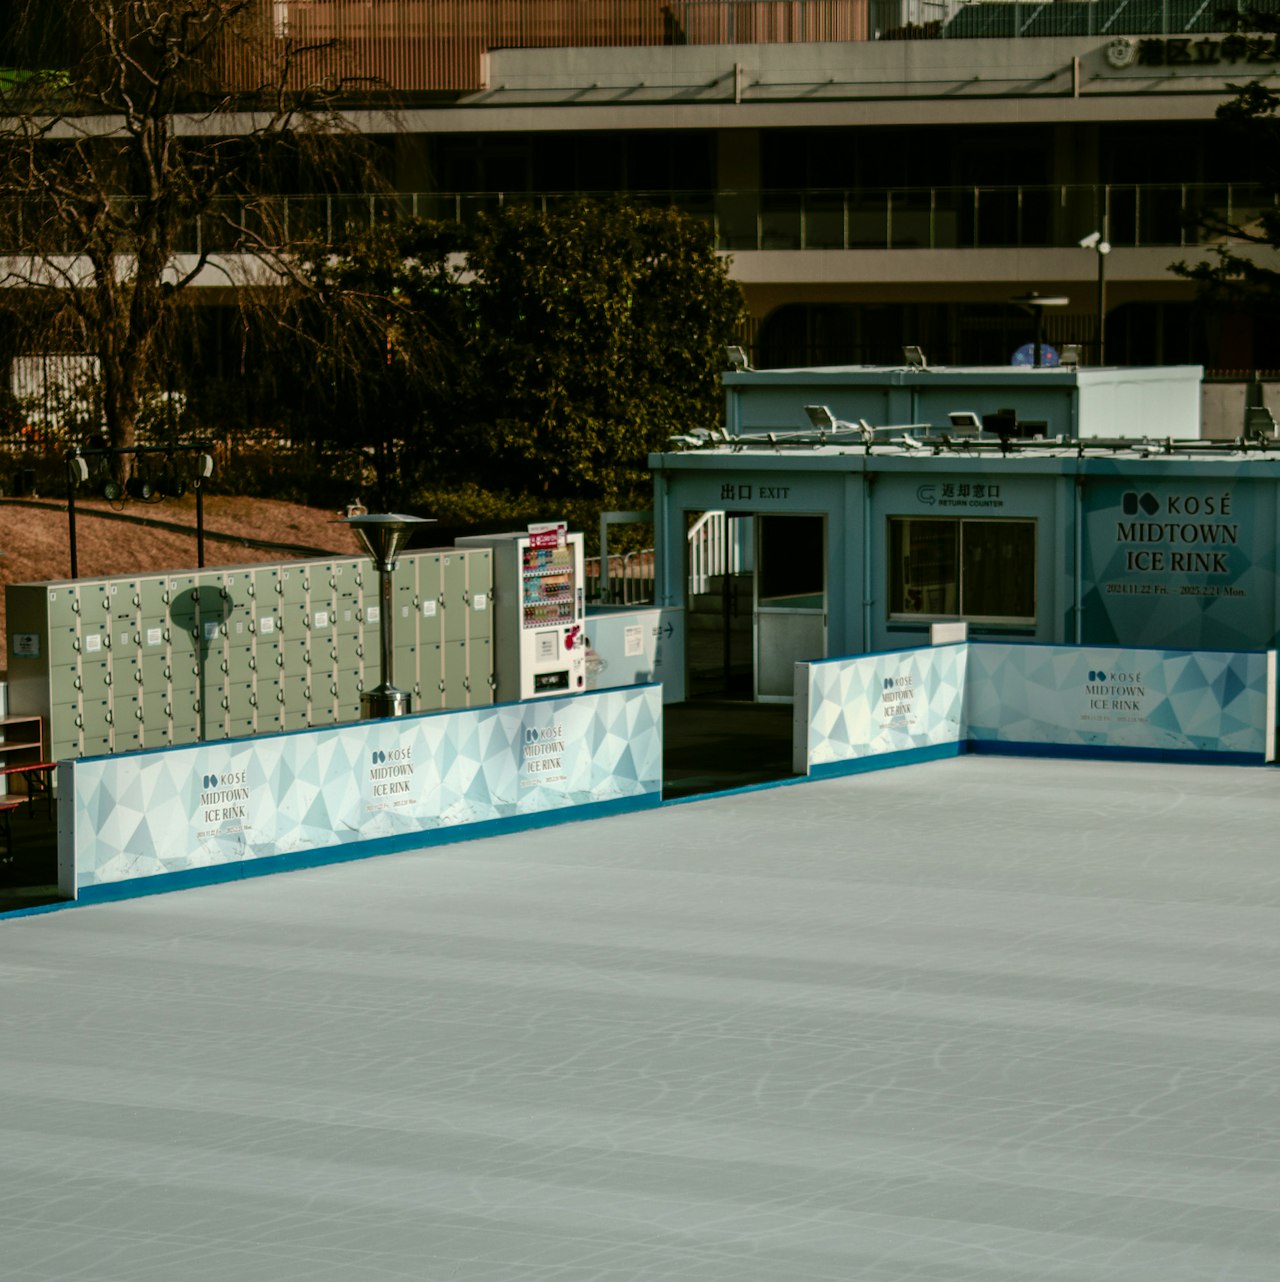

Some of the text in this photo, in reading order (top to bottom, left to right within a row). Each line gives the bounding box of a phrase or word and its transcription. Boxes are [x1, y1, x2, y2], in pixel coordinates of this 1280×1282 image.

[720, 484, 790, 500] 出口 EXIT
[942, 483, 1000, 498] 返却窓口
[939, 499, 967, 507] RETURN
[1168, 492, 1231, 515] KOSÉ
[1117, 523, 1238, 543] MIDTOWN
[1127, 552, 1227, 572] ICE RINK
[1110, 672, 1142, 683] KOSÉ
[1085, 685, 1145, 697] MIDTOWN
[1090, 699, 1140, 711] ICE RINK
[389, 746, 411, 761] KOSÉ
[524, 741, 565, 757] MIDTOWN
[370, 764, 414, 781] MIDTOWN
[528, 757, 561, 773] ICE RINK
[221, 769, 246, 785] KOSÉ
[374, 780, 410, 797] ICE RINK
[201, 788, 249, 806] MIDTOWN
[205, 806, 245, 823] ICE RINK
